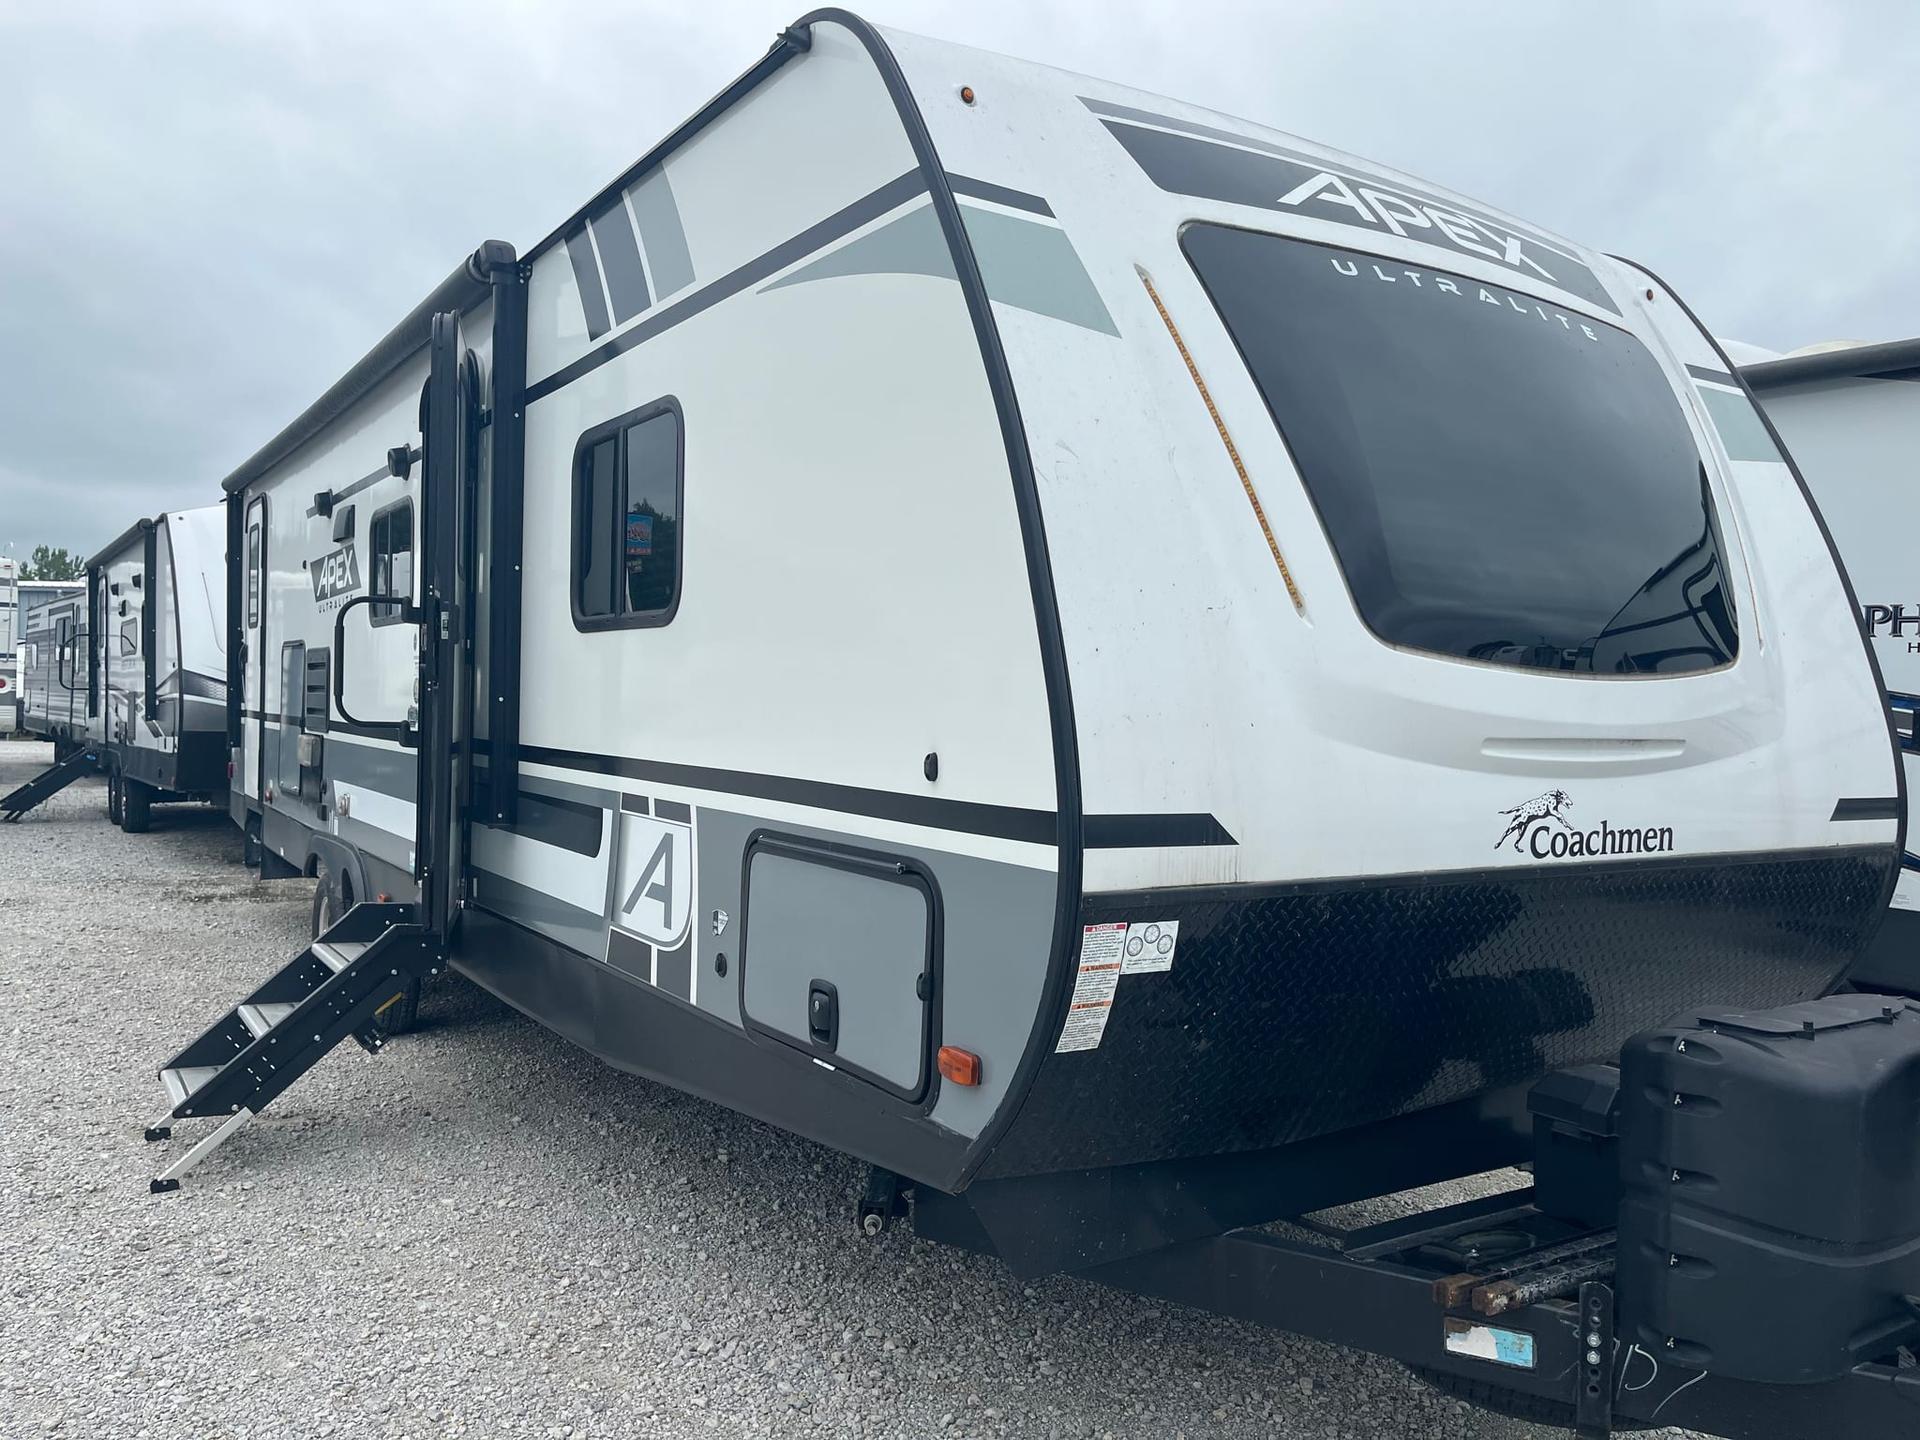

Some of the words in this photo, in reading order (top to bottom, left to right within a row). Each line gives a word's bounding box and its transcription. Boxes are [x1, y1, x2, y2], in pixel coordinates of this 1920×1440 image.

[1277, 172, 1557, 282] APEX
[1330, 257, 1599, 341] ULTRALITE
[316, 548, 353, 598] APEX
[621, 832, 673, 930] A
[1531, 821, 1673, 859] Coachmen
